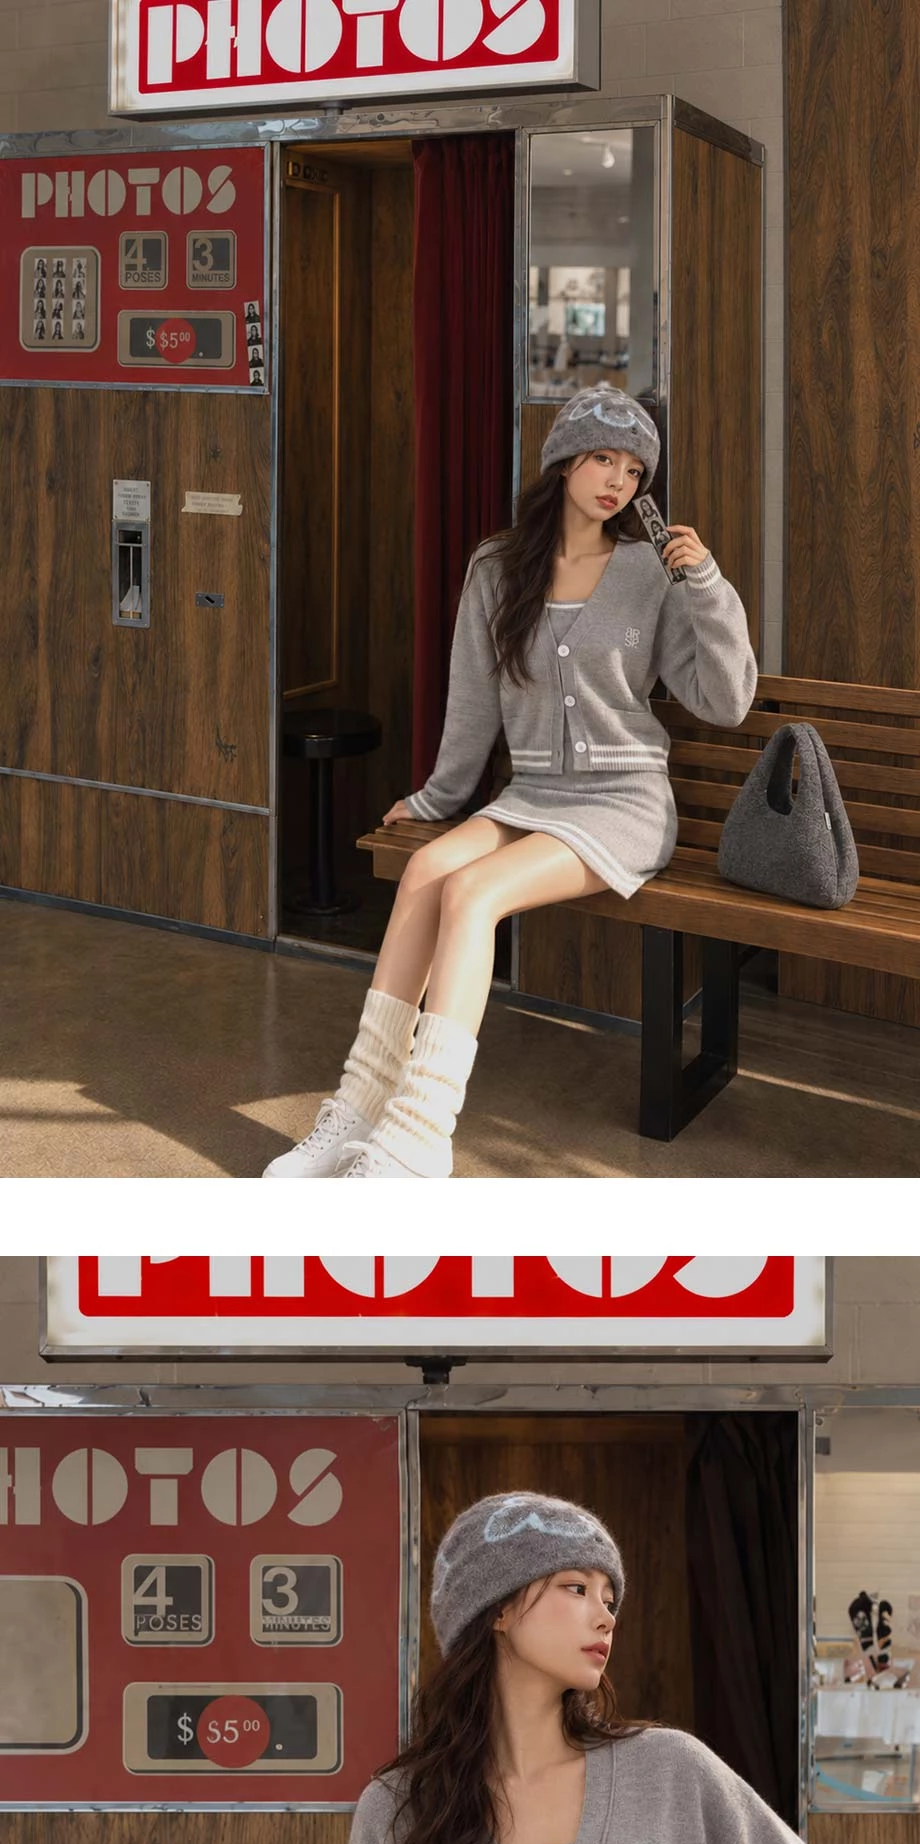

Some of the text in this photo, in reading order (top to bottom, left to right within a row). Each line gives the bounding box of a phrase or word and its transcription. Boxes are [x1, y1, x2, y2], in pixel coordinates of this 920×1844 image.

[147, 0, 546, 85] PHOTOS
[21, 165, 236, 219] PHOTOS
[125, 238, 147, 271] 4
[192, 238, 214, 272] 3
[125, 271, 161, 283] POSES
[192, 272, 230, 283] MINUTES
[0, 1447, 343, 1526] HOTOS
[133, 1565, 173, 1617] 4
[262, 1566, 299, 1616] 3
[135, 1614, 202, 1631] POSES
[263, 1616, 331, 1632] MINUTES
